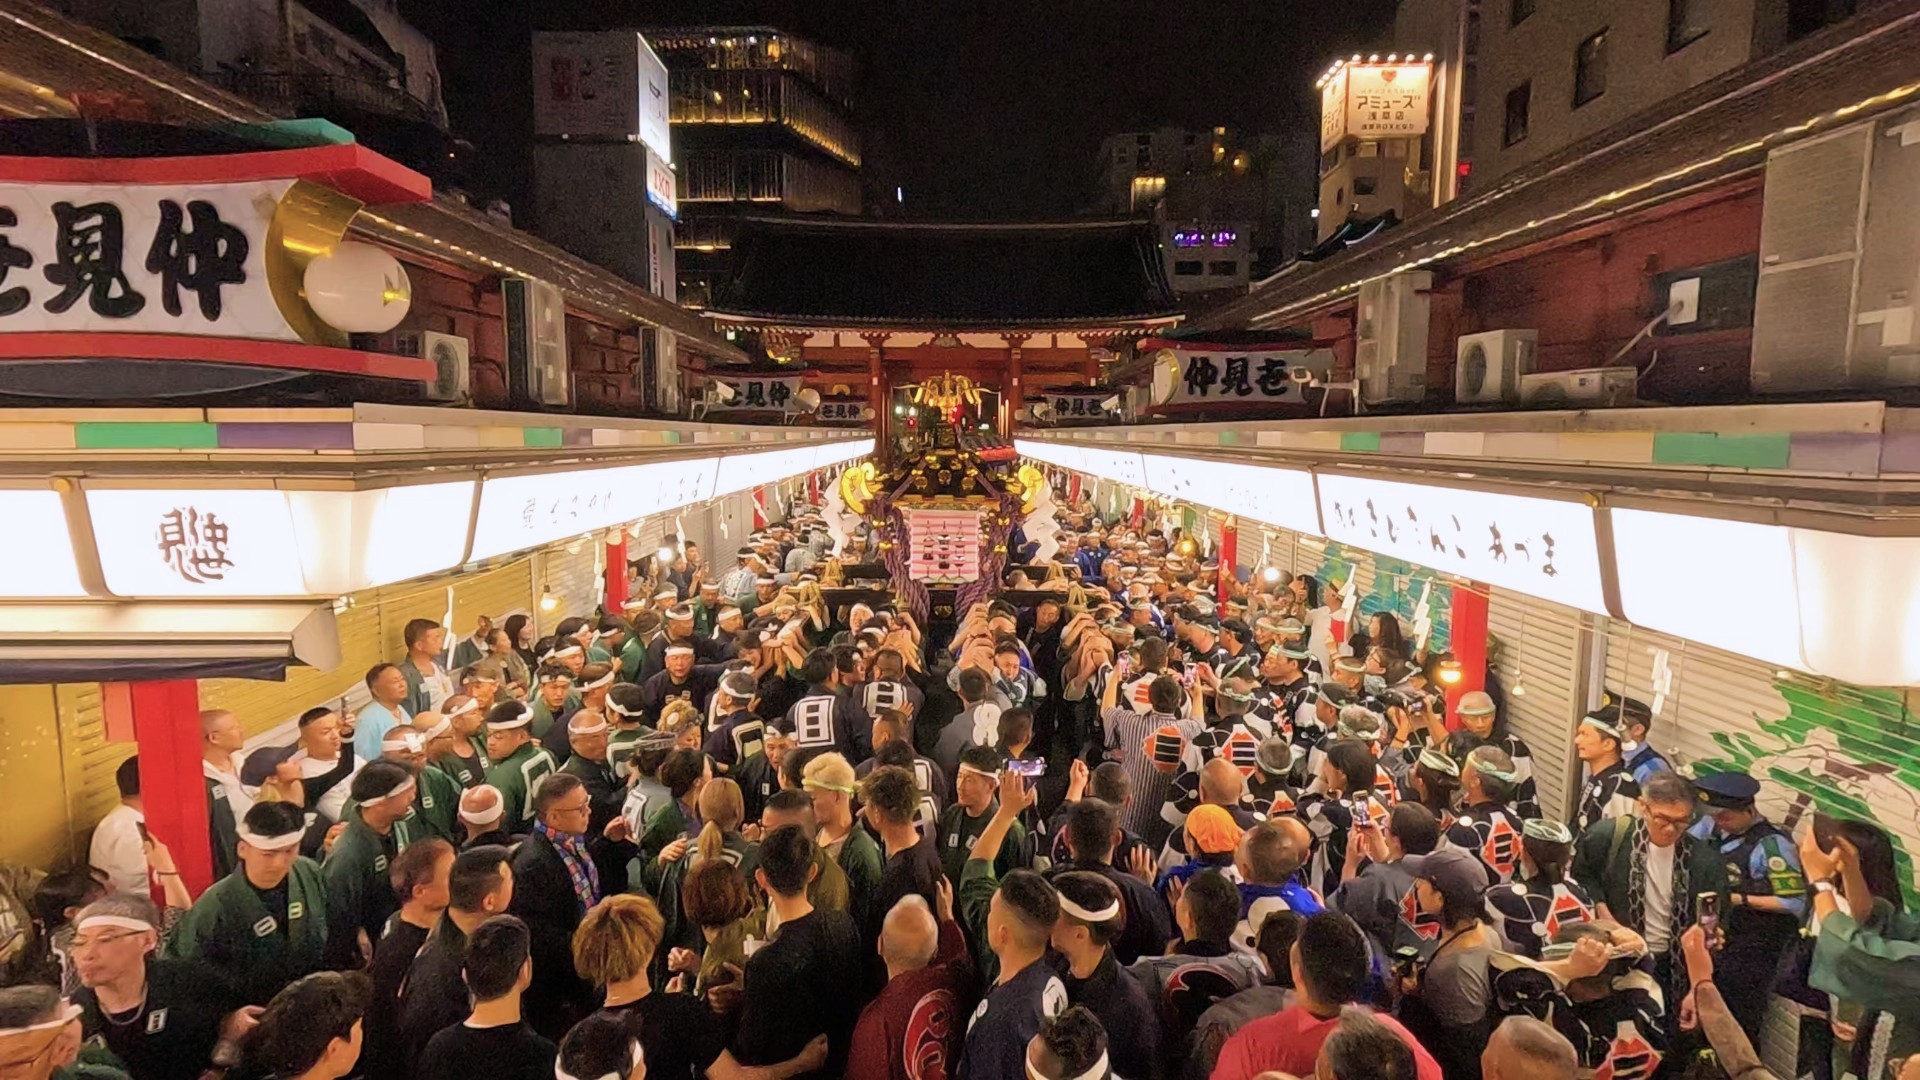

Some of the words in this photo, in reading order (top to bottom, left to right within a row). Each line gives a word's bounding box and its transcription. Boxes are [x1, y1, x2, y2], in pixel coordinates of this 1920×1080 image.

[1356, 95, 1420, 110] アミューズ
